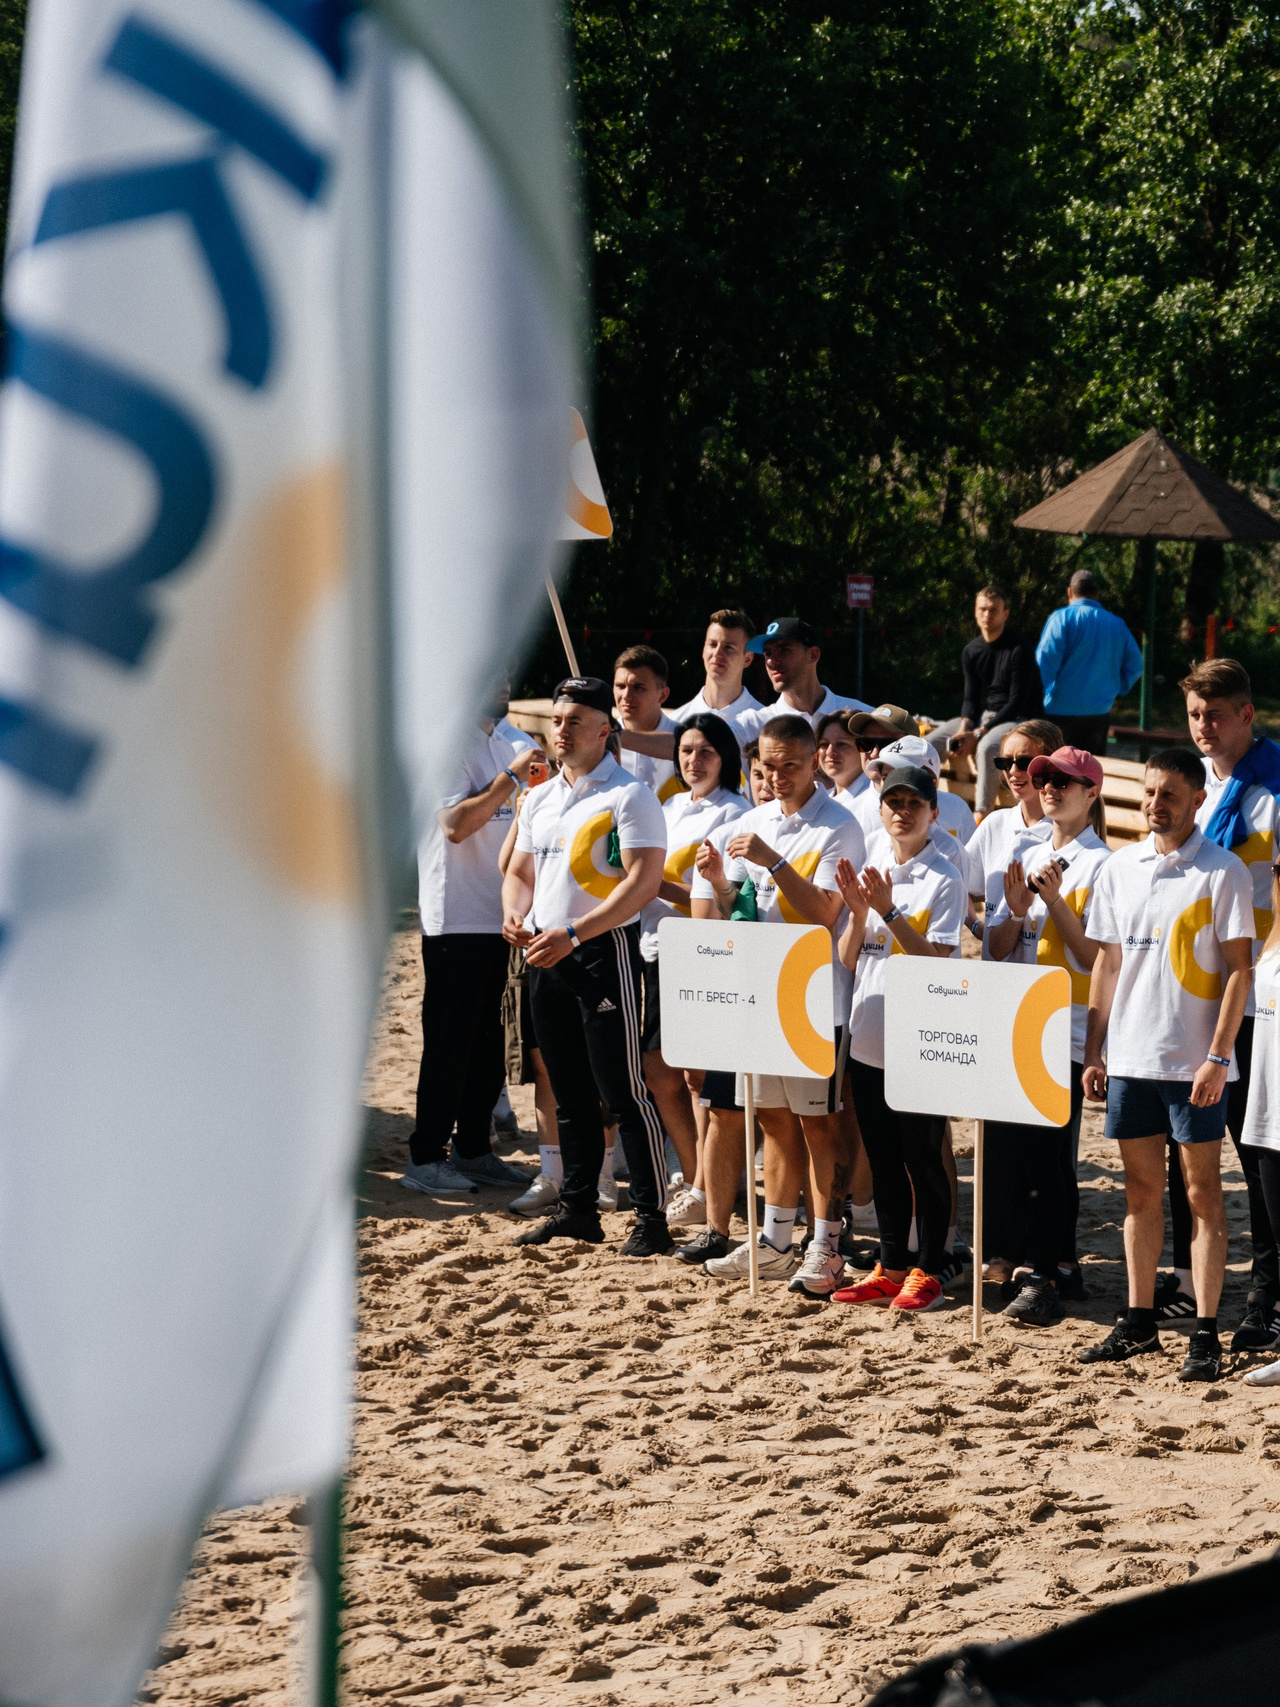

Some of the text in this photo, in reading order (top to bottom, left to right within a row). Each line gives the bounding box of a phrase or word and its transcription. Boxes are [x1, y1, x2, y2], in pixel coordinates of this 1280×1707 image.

[696, 944, 734, 957] Савушкин
[679, 989, 694, 1002] ПП
[697, 990, 705, 1003] Г.
[706, 991, 740, 1005] БРЕСТ
[748, 994, 757, 1006] 4
[927, 983, 968, 997] Савушкин
[918, 1029, 978, 1046] ТОРГОВАЯ
[919, 1048, 977, 1066] КОМАНДА
